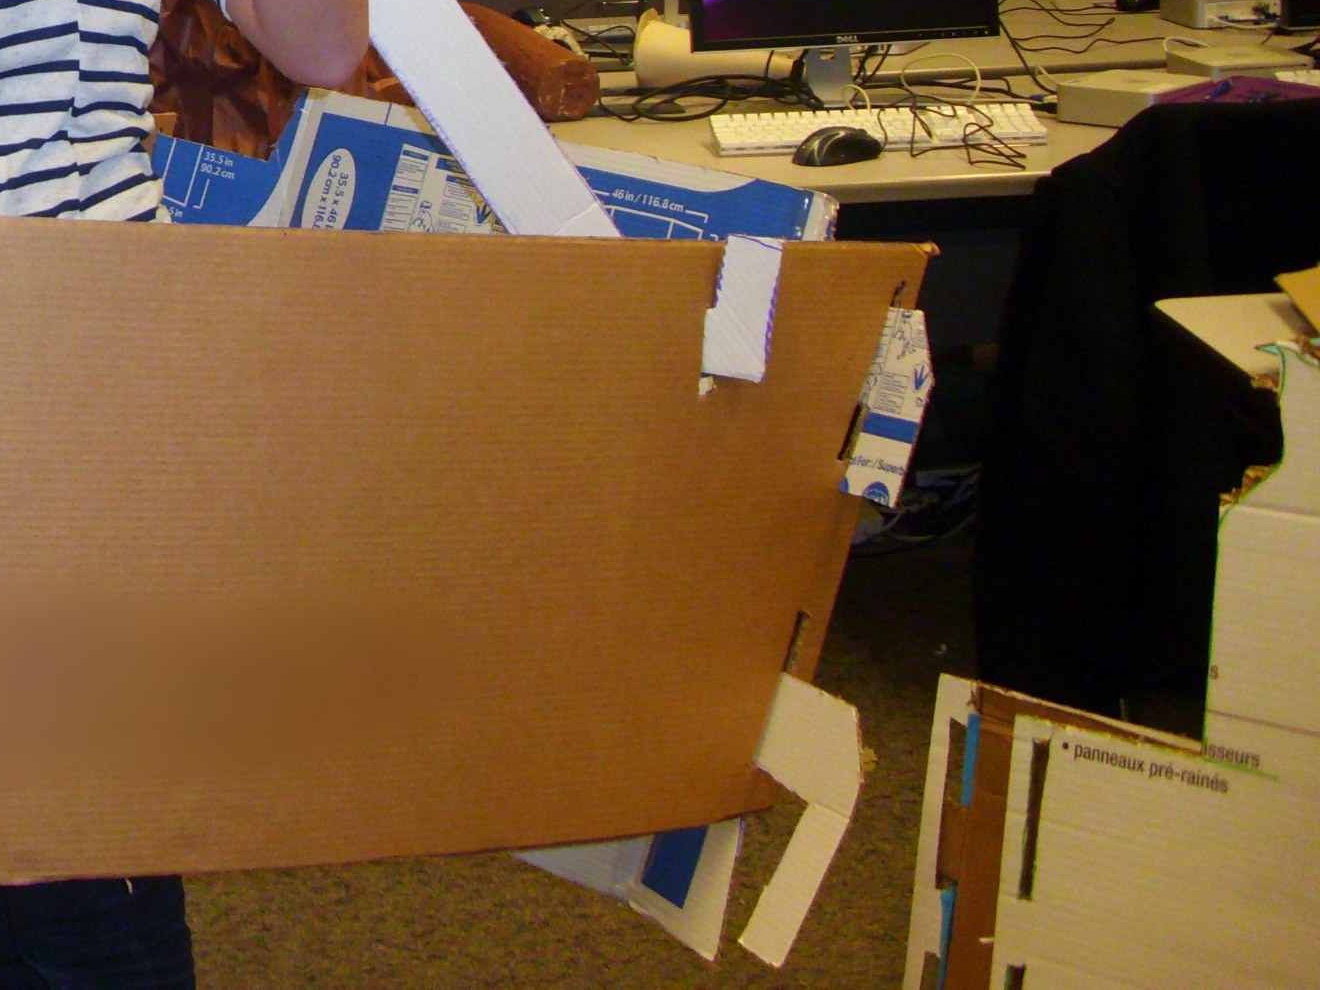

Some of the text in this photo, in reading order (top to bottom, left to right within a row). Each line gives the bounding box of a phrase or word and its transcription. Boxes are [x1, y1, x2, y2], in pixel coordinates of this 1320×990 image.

[203, 151, 234, 167] 35.5 in
[327, 154, 341, 178] 90.2
[200, 163, 236, 180] 90.2 cm
[322, 178, 332, 195] cm
[335, 172, 349, 197] 35.5
[612, 188, 625, 199] 46
[624, 190, 634, 201] in
[642, 194, 669, 209] 116.8
[669, 202, 684, 212] cm
[327, 208, 338, 223] 46
[1074, 743, 1229, 794] panneaux pré-rainés
